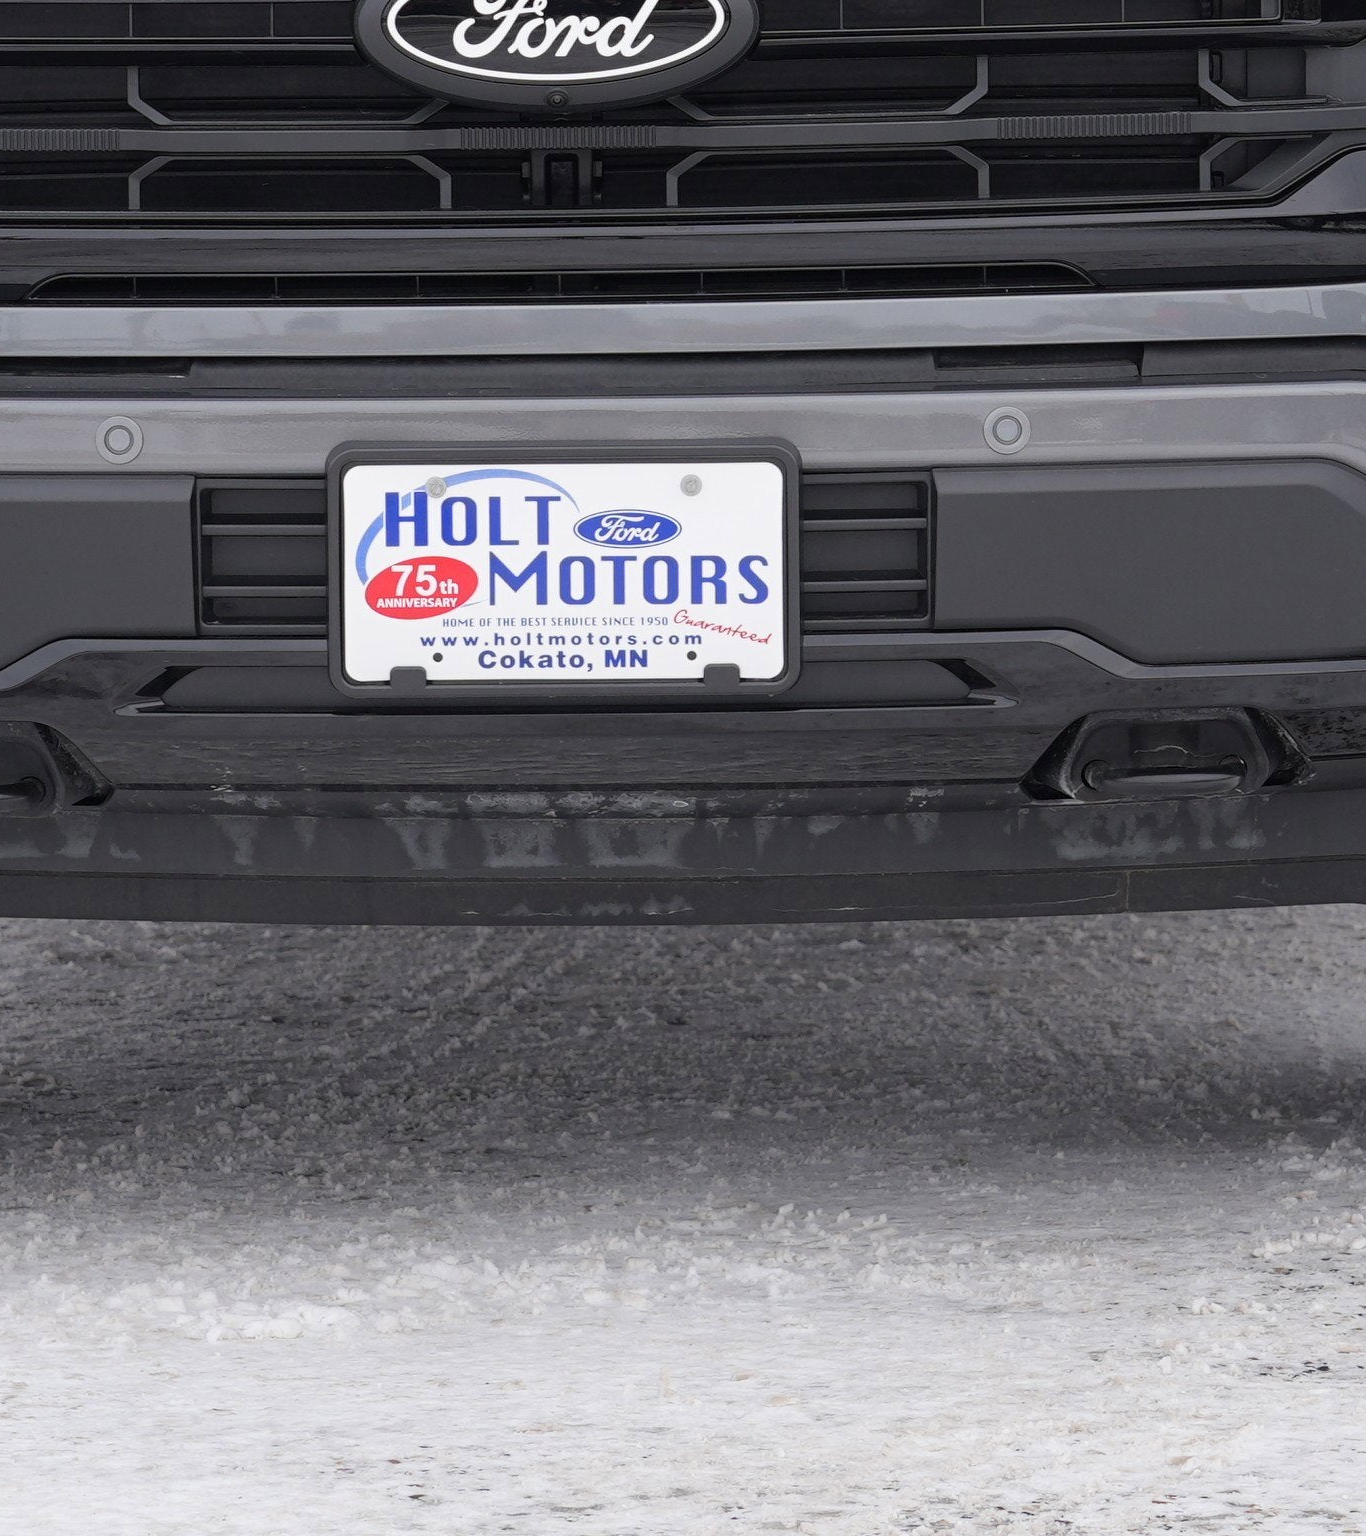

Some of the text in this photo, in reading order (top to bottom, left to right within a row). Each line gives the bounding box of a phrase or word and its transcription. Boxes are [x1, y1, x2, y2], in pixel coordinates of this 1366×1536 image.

[384, 491, 561, 547] HOLT
[593, 514, 660, 544] Ford
[390, 564, 459, 597] 75th
[488, 550, 769, 606] MOTORS
[376, 597, 458, 609] ANNIVERSARY
[442, 616, 669, 627] HOME OF THE BEST SERVICE SINCE 1950
[674, 609, 773, 645] Guaranteed
[419, 632, 703, 647] www.holtmotors.com
[477, 649, 648, 671] Cokato, MN
